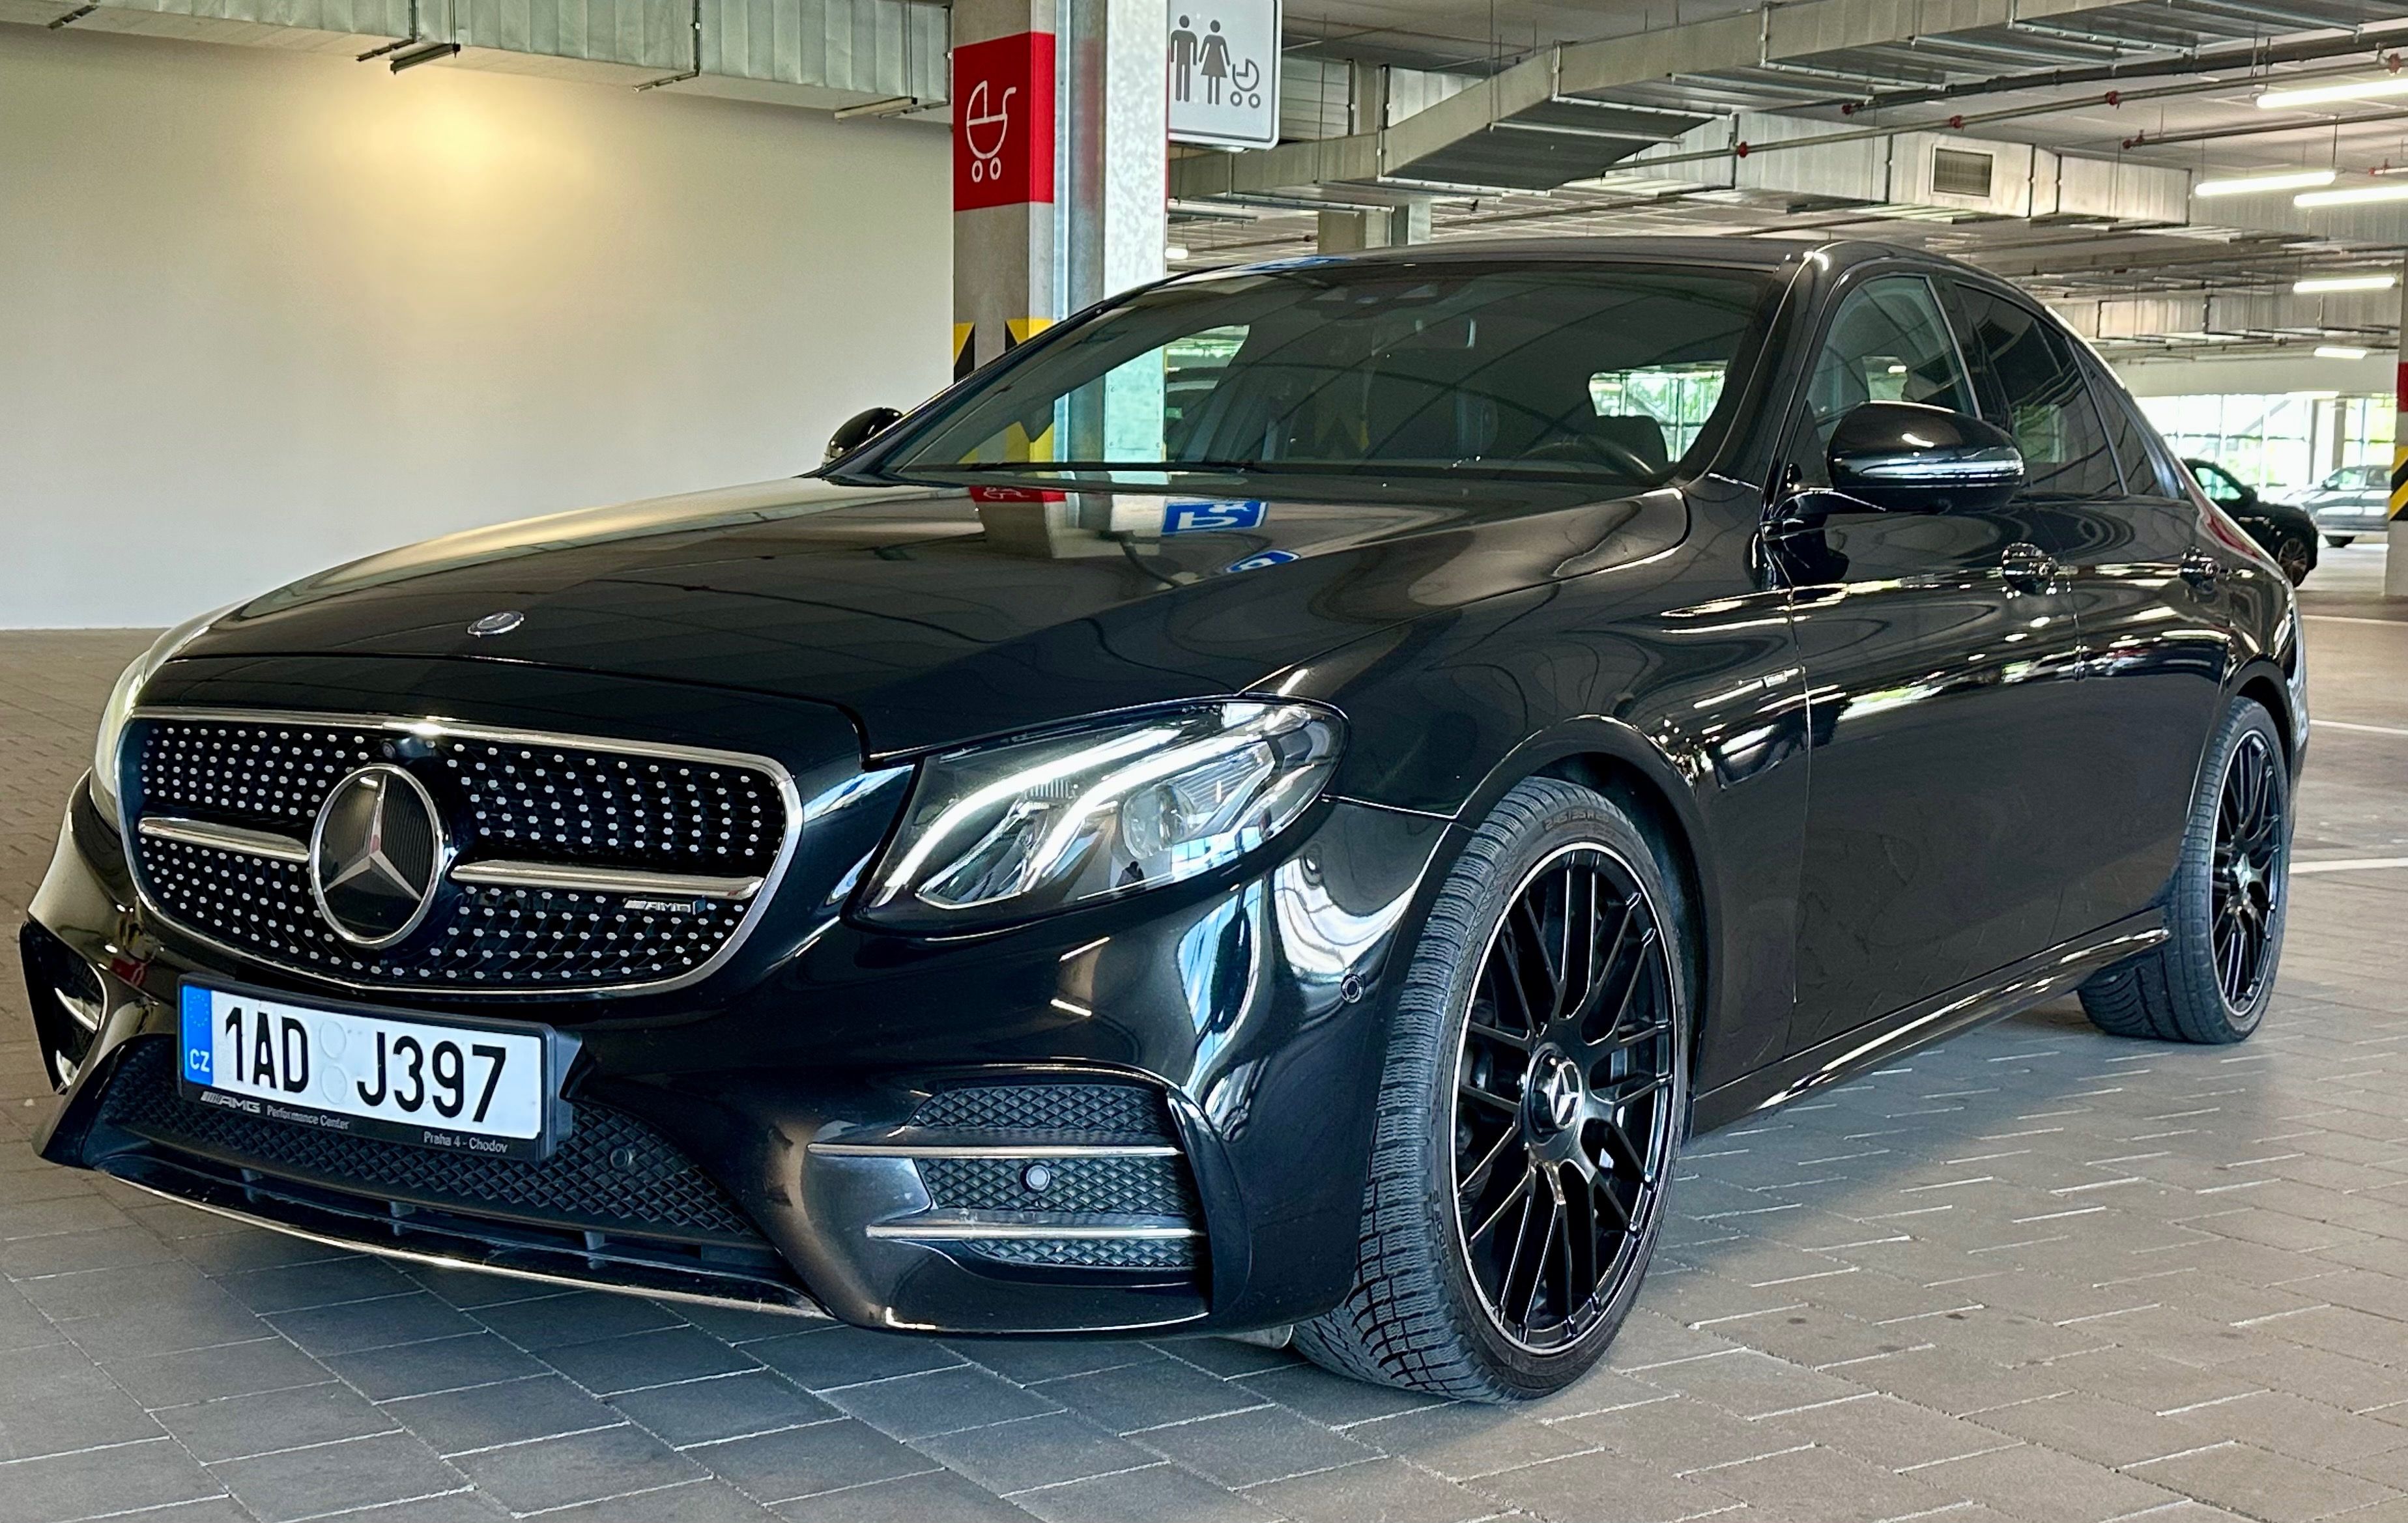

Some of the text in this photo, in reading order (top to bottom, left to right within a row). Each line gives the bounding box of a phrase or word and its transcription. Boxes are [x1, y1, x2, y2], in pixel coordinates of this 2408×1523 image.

[642, 901, 691, 913] AMG
[190, 1048, 210, 1073] CZ
[225, 1006, 506, 1123] 1AD J397
[218, 1095, 350, 1130] AMG Performance Center
[423, 1131, 452, 1146] Praha
[453, 1135, 461, 1148] 4
[468, 1137, 508, 1154] Chodov
